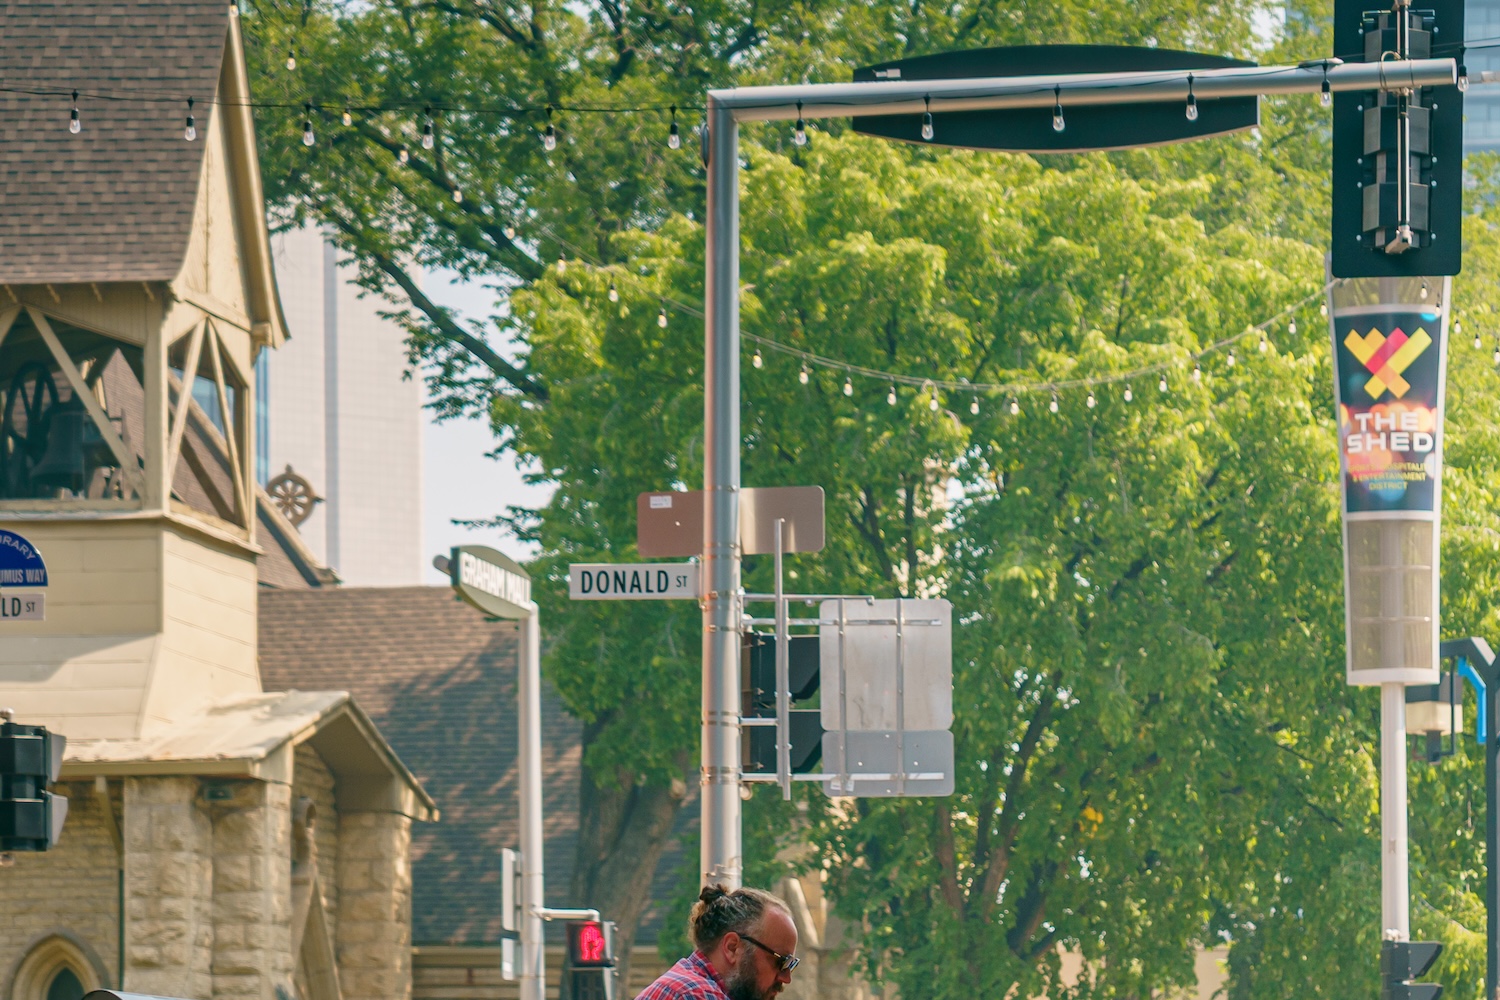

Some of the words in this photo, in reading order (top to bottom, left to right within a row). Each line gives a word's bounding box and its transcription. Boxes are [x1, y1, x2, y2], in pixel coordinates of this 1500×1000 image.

[1354, 412, 1418, 431] THE
[1347, 432, 1433, 453] SHED
[0, 535, 36, 559] RARY
[25, 568, 45, 583] WAY
[581, 570, 669, 594] DONALD
[675, 575, 688, 588] ST
[1, 597, 22, 617] LD
[26, 602, 36, 613] ST
